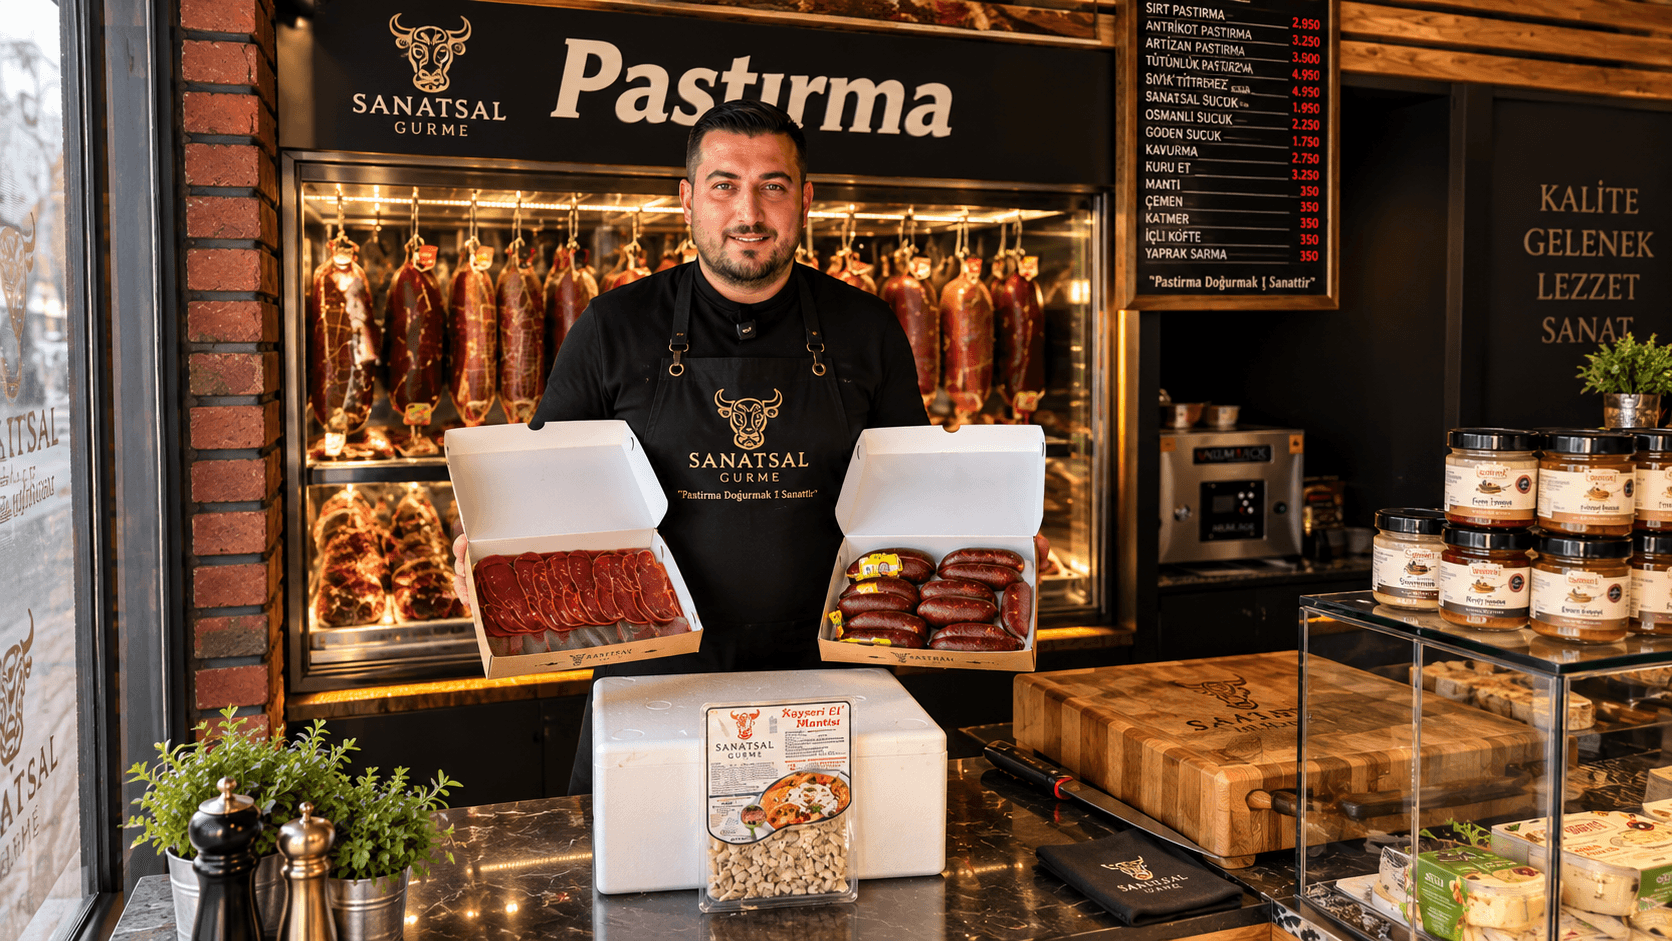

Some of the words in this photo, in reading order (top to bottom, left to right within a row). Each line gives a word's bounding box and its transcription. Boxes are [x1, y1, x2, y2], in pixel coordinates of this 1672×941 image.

[1145, 2, 1170, 15] SIRT
[1172, 4, 1226, 20] PASTIRMA
[1201, 26, 1252, 40] PASTIRMA
[1145, 36, 1192, 52] ARTİZAN
[1195, 42, 1245, 56] PASTIRMA
[1292, 34, 1320, 48] 3.250
[1292, 68, 1320, 81] 4.950
[1145, 91, 1200, 105] SANATSAL
[1292, 85, 1320, 98] 4.950
[352, 93, 507, 121] SANATSAL
[1292, 101, 1320, 114] 1.950
[1145, 109, 1194, 122] OSMANLI
[1197, 111, 1233, 125] SUCUK
[394, 121, 468, 137] GURME
[1292, 118, 1320, 131] 2.250
[1186, 128, 1222, 142] SUCUK
[1292, 135, 1320, 148] 1.750
[1145, 144, 1199, 157] KAVURMA
[1292, 152, 1320, 165] 2.750
[1145, 161, 1175, 174] KURU
[1177, 162, 1191, 175] ET
[1291, 169, 1320, 181] 3.250
[1145, 179, 1181, 191] MANTI
[1300, 185, 1319, 197] 350
[1145, 195, 1183, 210] ÇEMEN
[1540, 180, 1639, 214] KALİTE
[1300, 201, 1319, 213] 350
[1145, 213, 1190, 225] KATMER
[1300, 217, 1319, 229] 350
[1300, 234, 1319, 246] 350
[1523, 227, 1655, 258] GELENEK
[1145, 247, 1188, 259] YAPRAK
[1190, 248, 1228, 260] SARMA
[1300, 250, 1319, 262] 350
[1537, 273, 1640, 300] LEZZET
[1541, 316, 1634, 343] SANAT
[689, 452, 809, 469] SANATSAL
[719, 473, 780, 483] GURME
[724, 489, 772, 502] Doğurmak
[715, 741, 775, 752] SANATSAL
